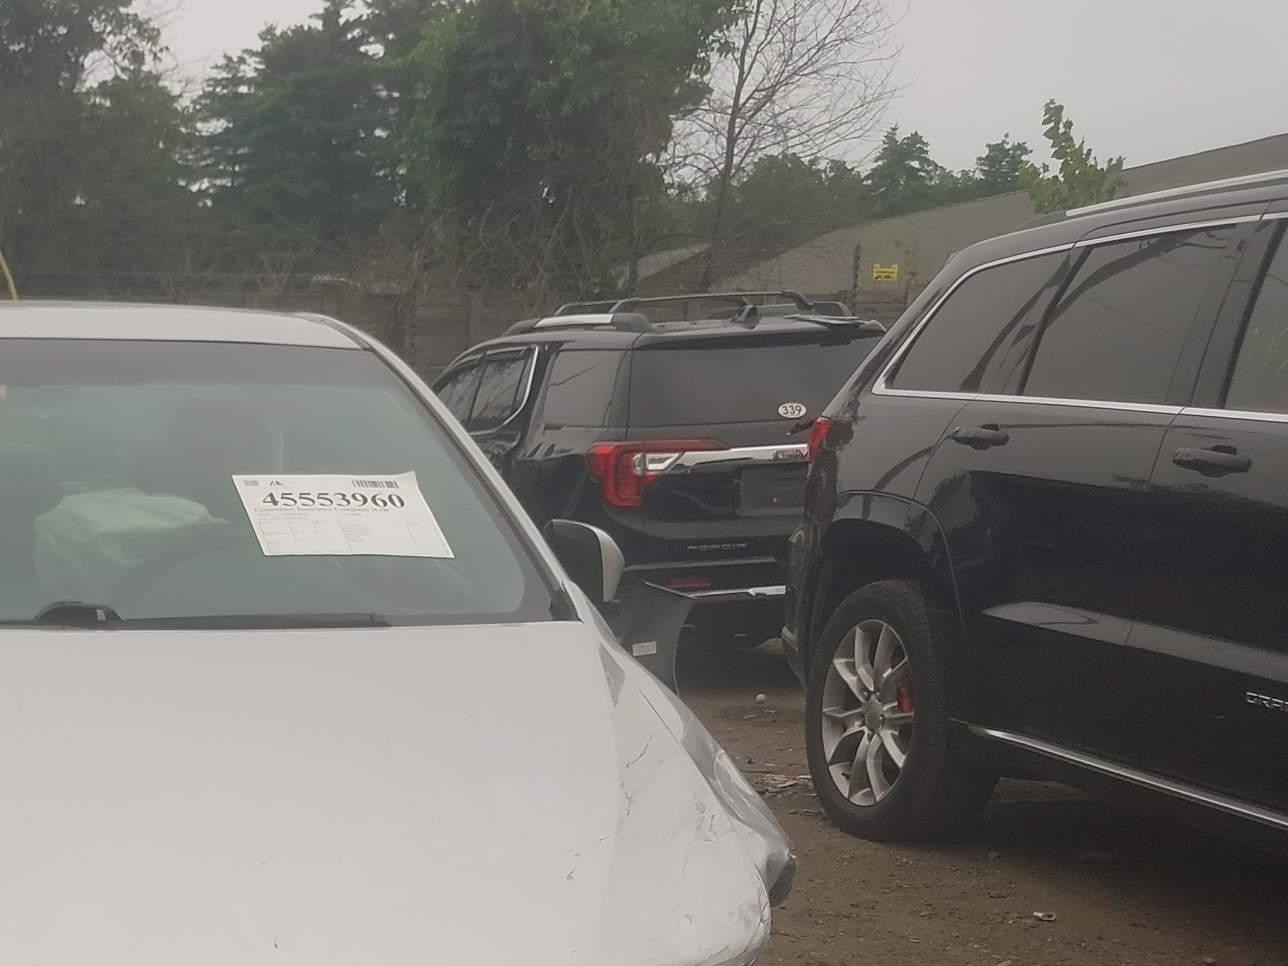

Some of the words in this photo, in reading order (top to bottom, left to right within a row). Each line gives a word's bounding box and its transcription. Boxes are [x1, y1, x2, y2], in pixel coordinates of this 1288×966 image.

[782, 405, 802, 415] 339
[775, 448, 809, 460] GM
[262, 492, 406, 508] 45553960
[1245, 691, 1288, 712] GRA
